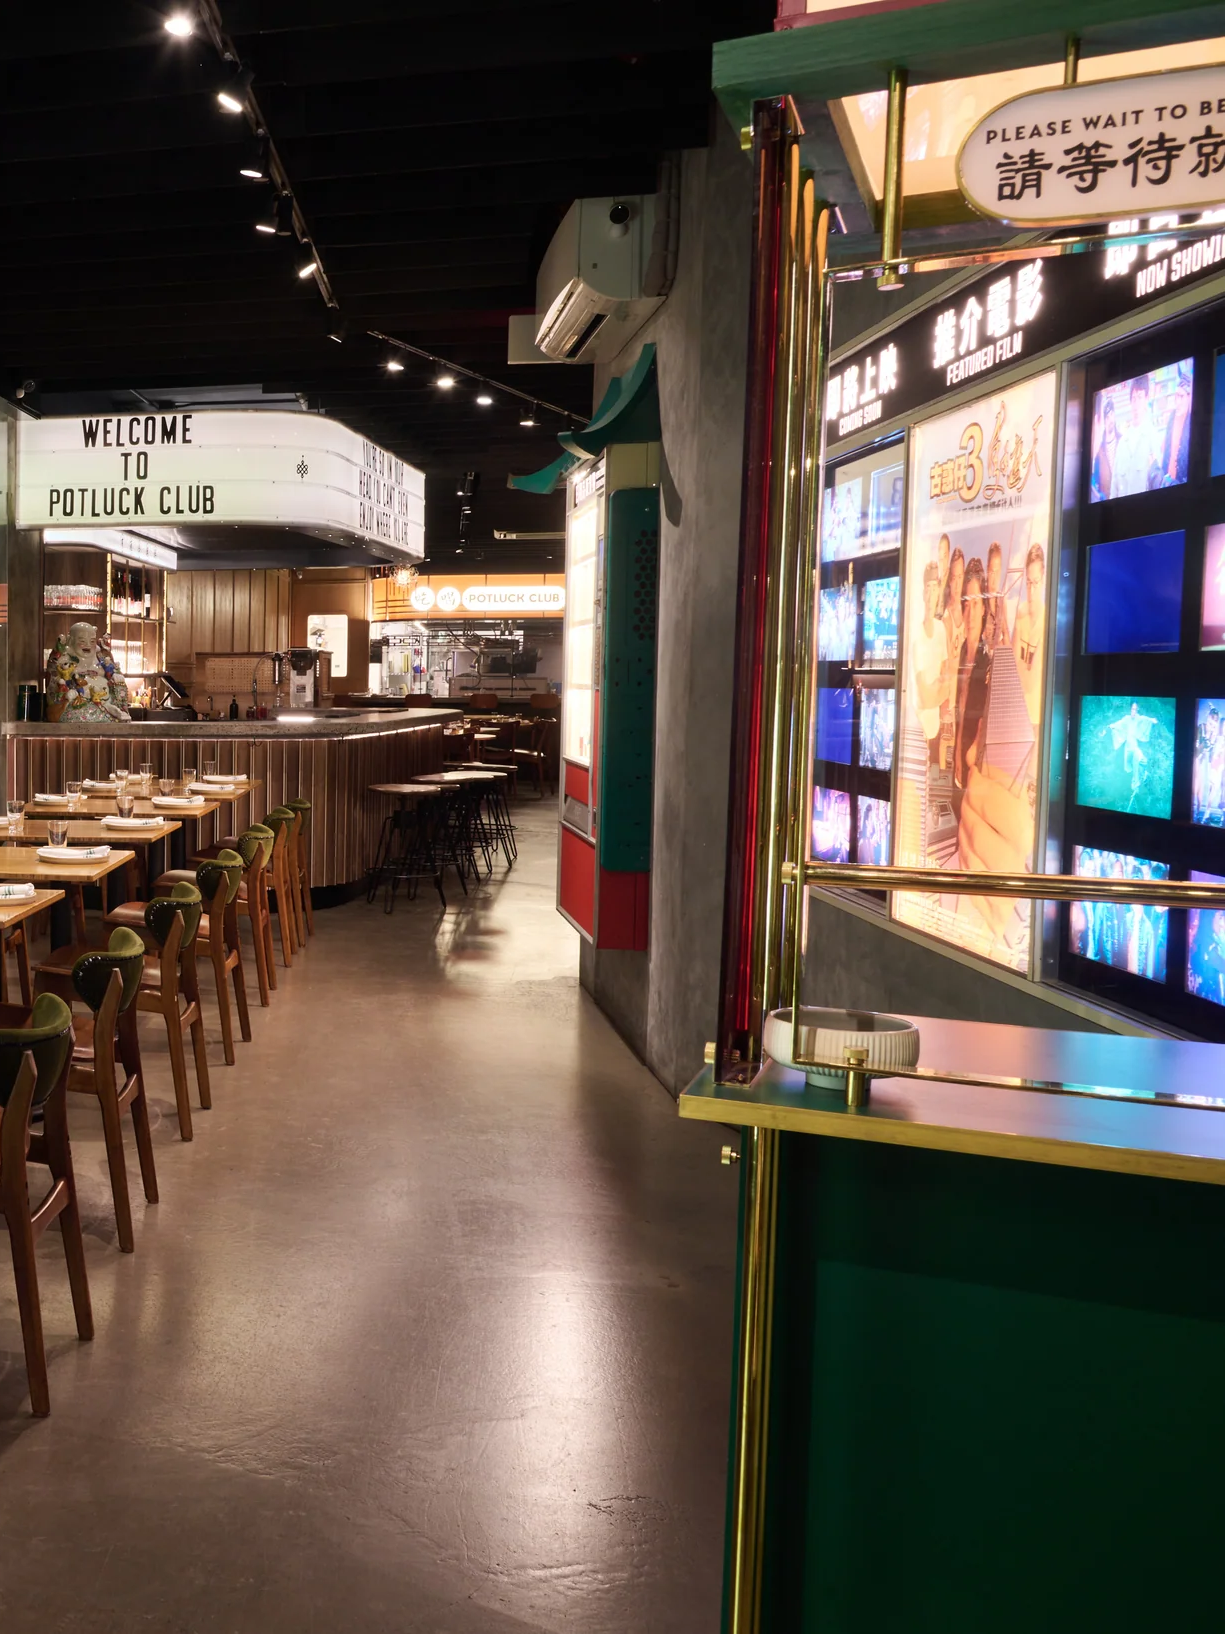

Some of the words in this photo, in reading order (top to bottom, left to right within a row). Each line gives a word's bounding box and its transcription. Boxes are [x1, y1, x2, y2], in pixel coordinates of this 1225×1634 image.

[986, 120, 1071, 144] PLEASE
[1083, 110, 1143, 131] WAIT
[1154, 104, 1187, 122] TO
[1200, 99, 1225, 116] BE
[1136, 259, 1168, 298] NOW
[1171, 232, 1225, 282] SHOWI
[933, 258, 1043, 368] 推介電影
[946, 345, 994, 386] FEATURED
[995, 331, 1022, 364] FILM
[82, 414, 193, 448] WELCOME
[120, 451, 149, 481] TO
[49, 486, 145, 517] POTLUCK
[159, 485, 215, 515] CLUB
[469, 593, 525, 603] POTLUCK
[529, 593, 560, 603] CLUB
